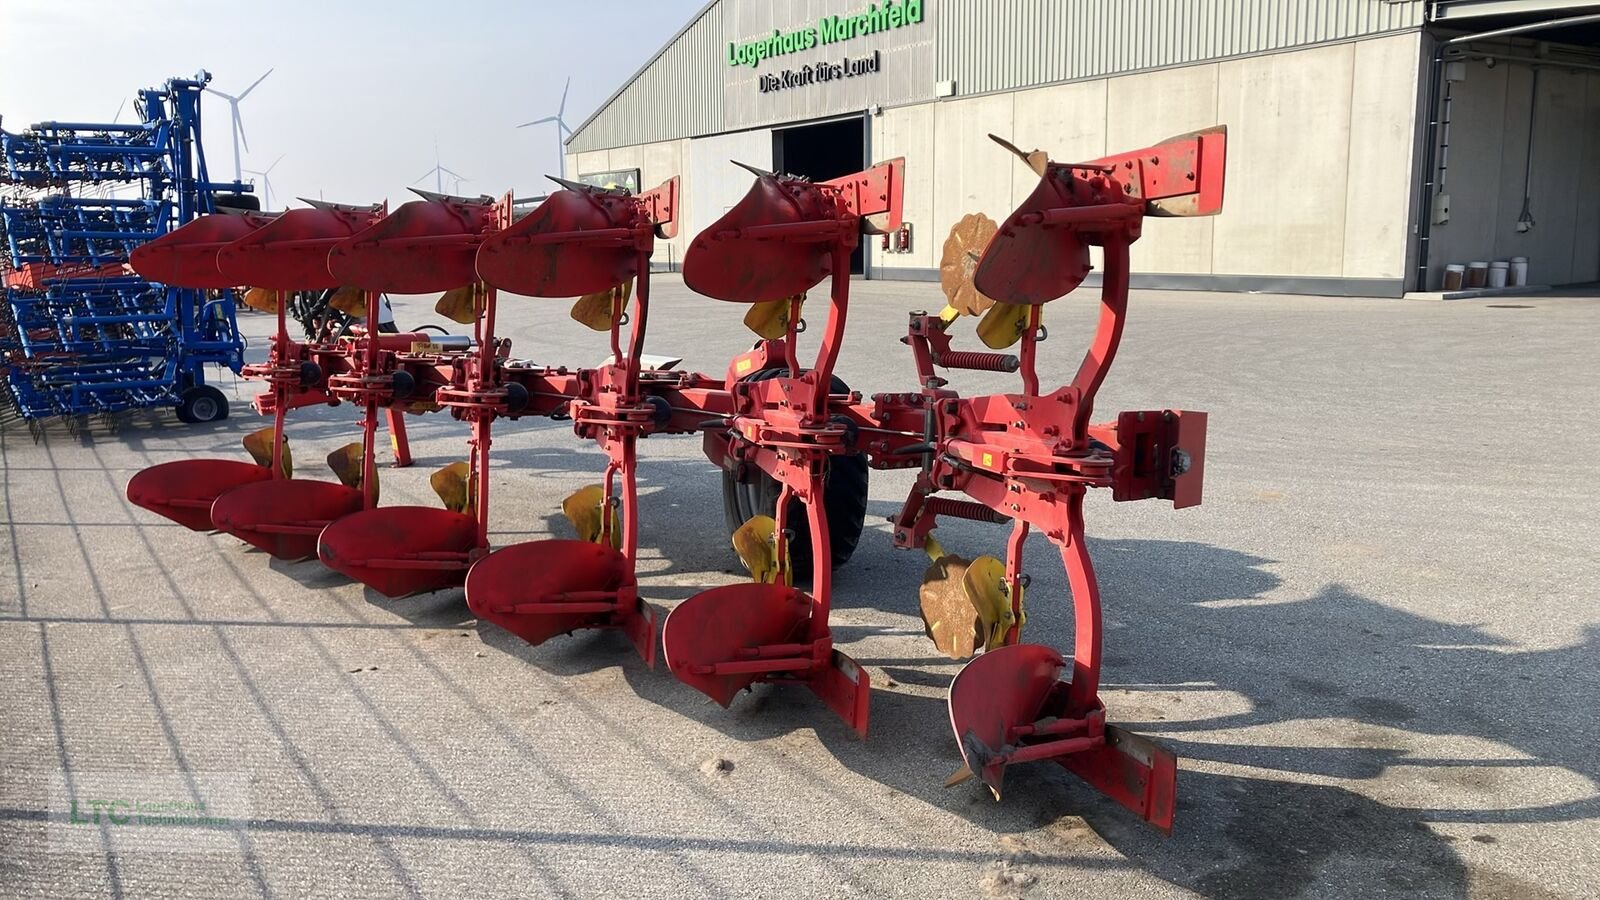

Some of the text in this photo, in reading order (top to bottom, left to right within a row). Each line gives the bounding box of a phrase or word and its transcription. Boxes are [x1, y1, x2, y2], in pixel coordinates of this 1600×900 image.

[728, 0, 924, 68] Lagerhaus Marchfeld
[759, 49, 881, 93] Die Kraft fürs Land
